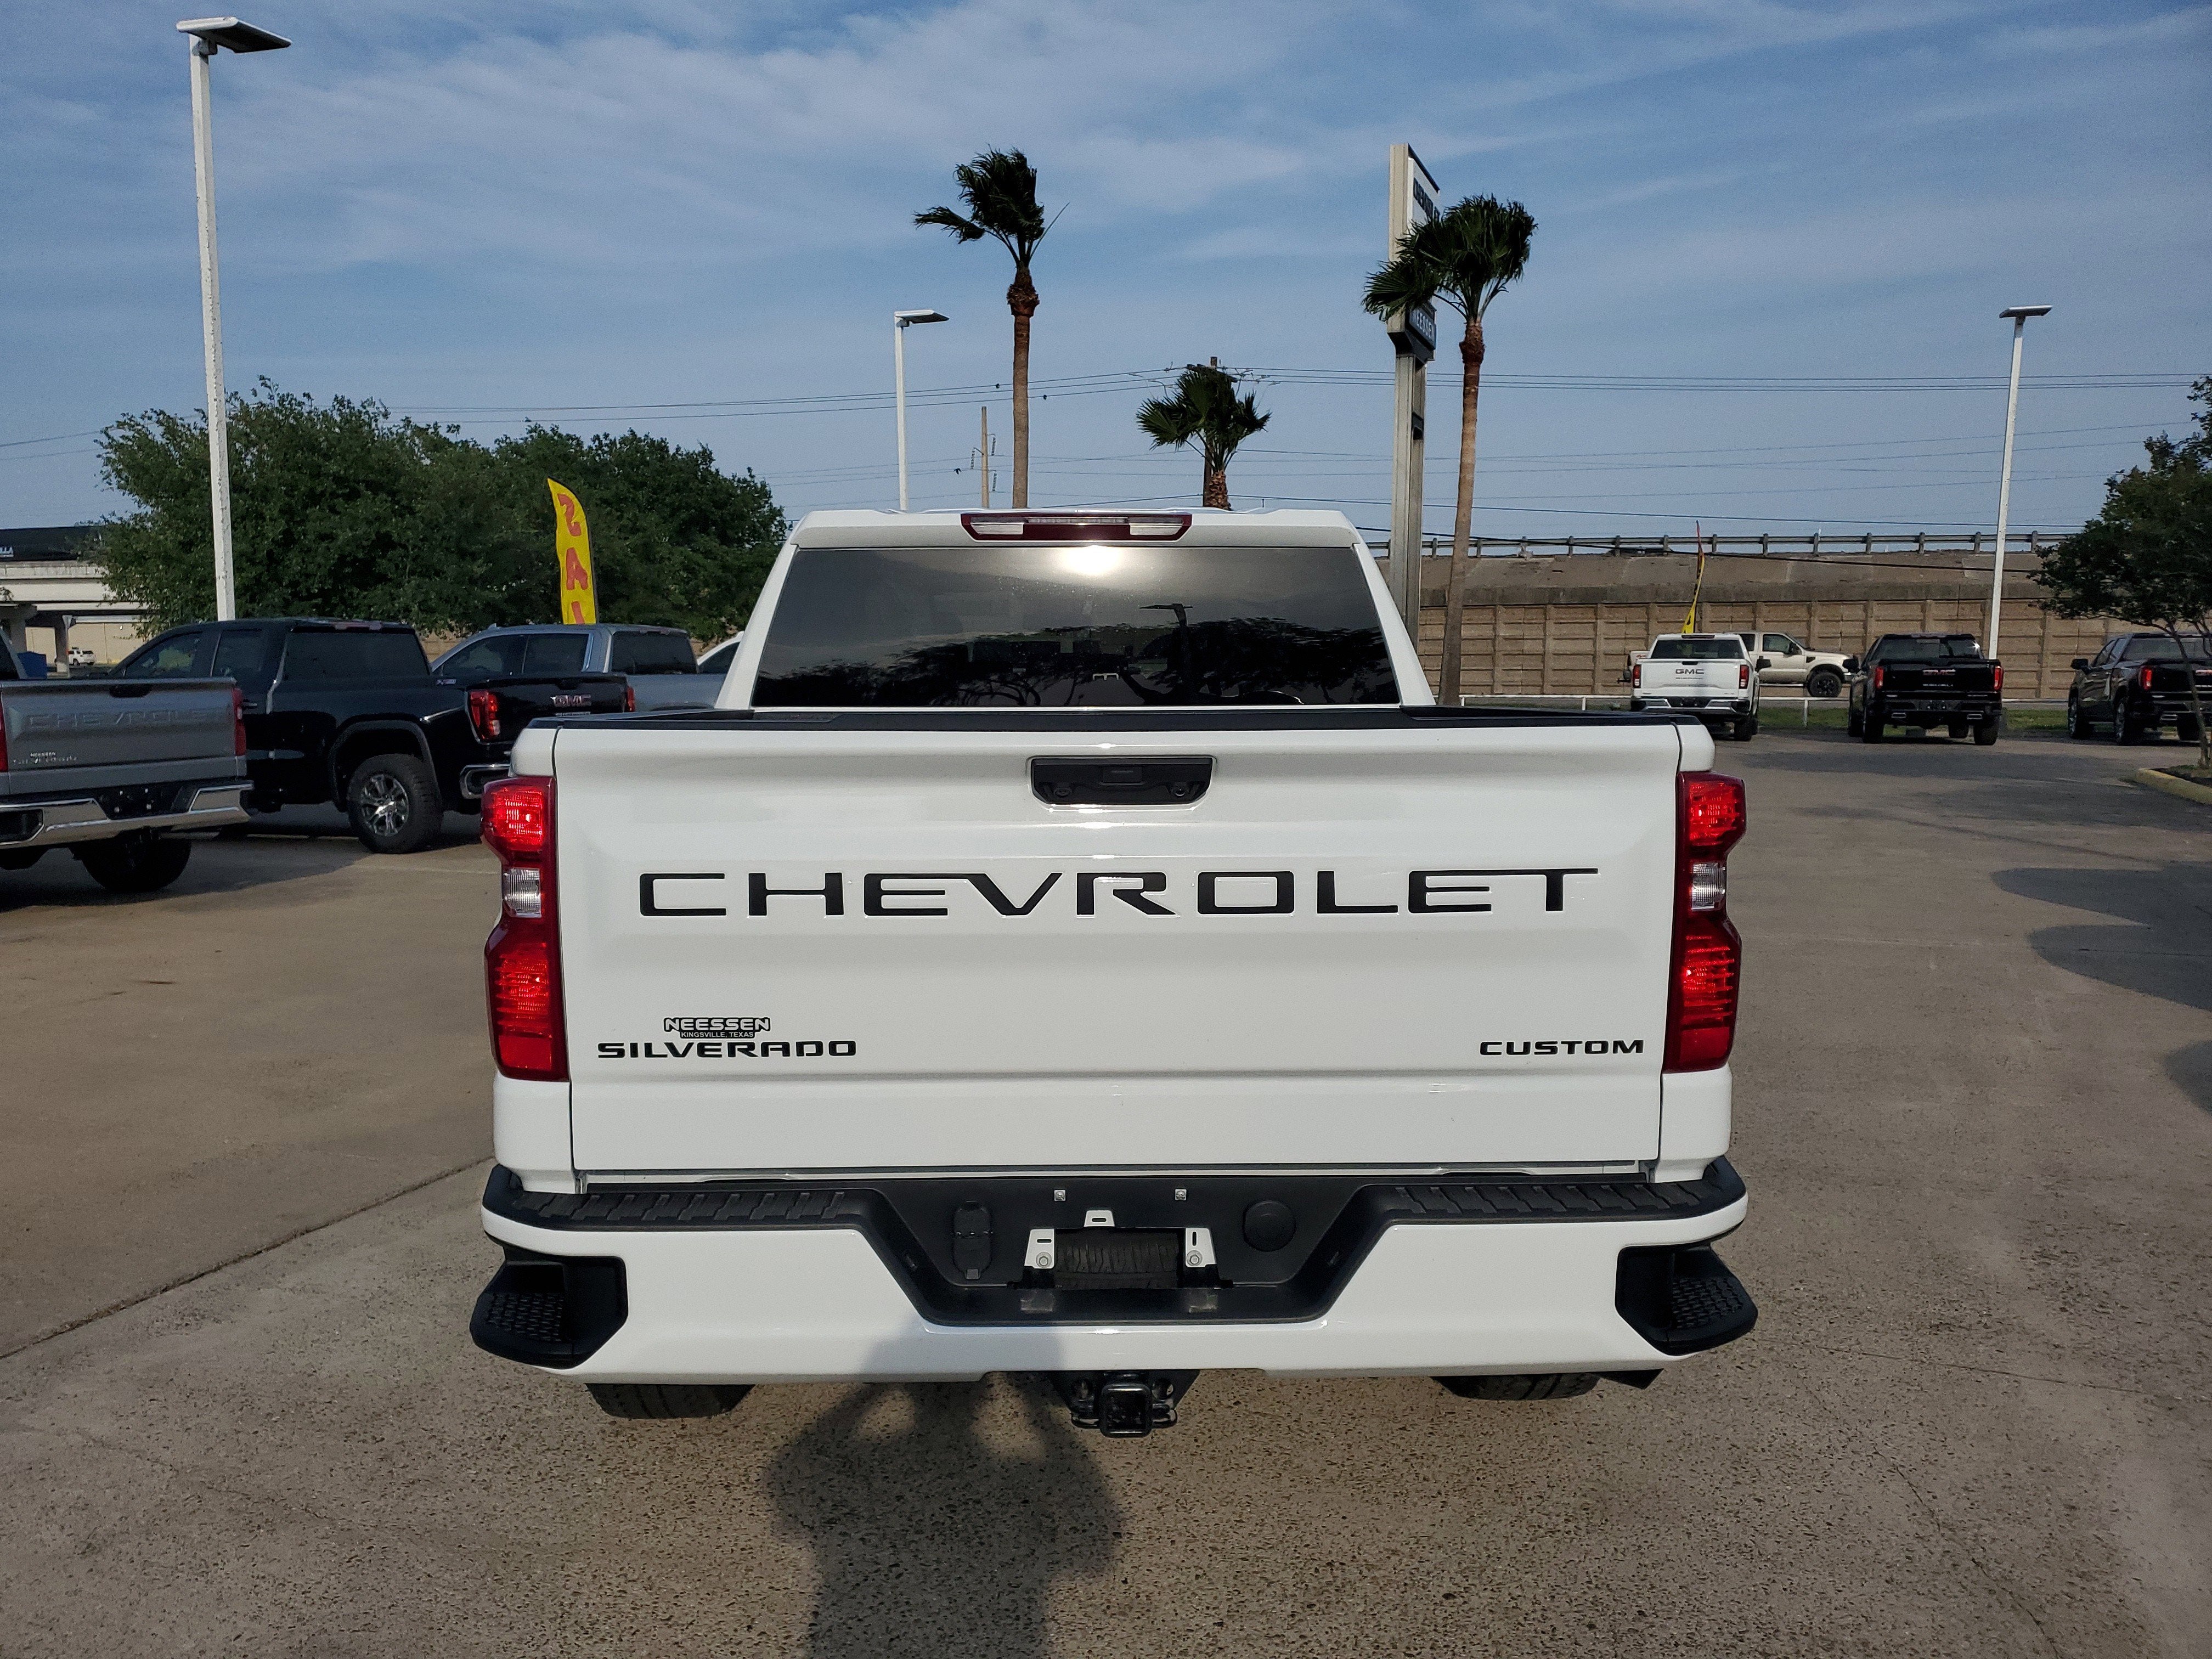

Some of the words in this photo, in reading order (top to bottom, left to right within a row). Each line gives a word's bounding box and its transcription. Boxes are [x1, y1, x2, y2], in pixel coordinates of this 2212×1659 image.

[554, 695, 592, 707] GMC
[639, 867, 1599, 917] CHEVROLET
[665, 1018, 769, 1031] NEESSEN
[597, 1040, 857, 1058] SILVERADO
[1479, 1040, 1644, 1056] CUSTOM
